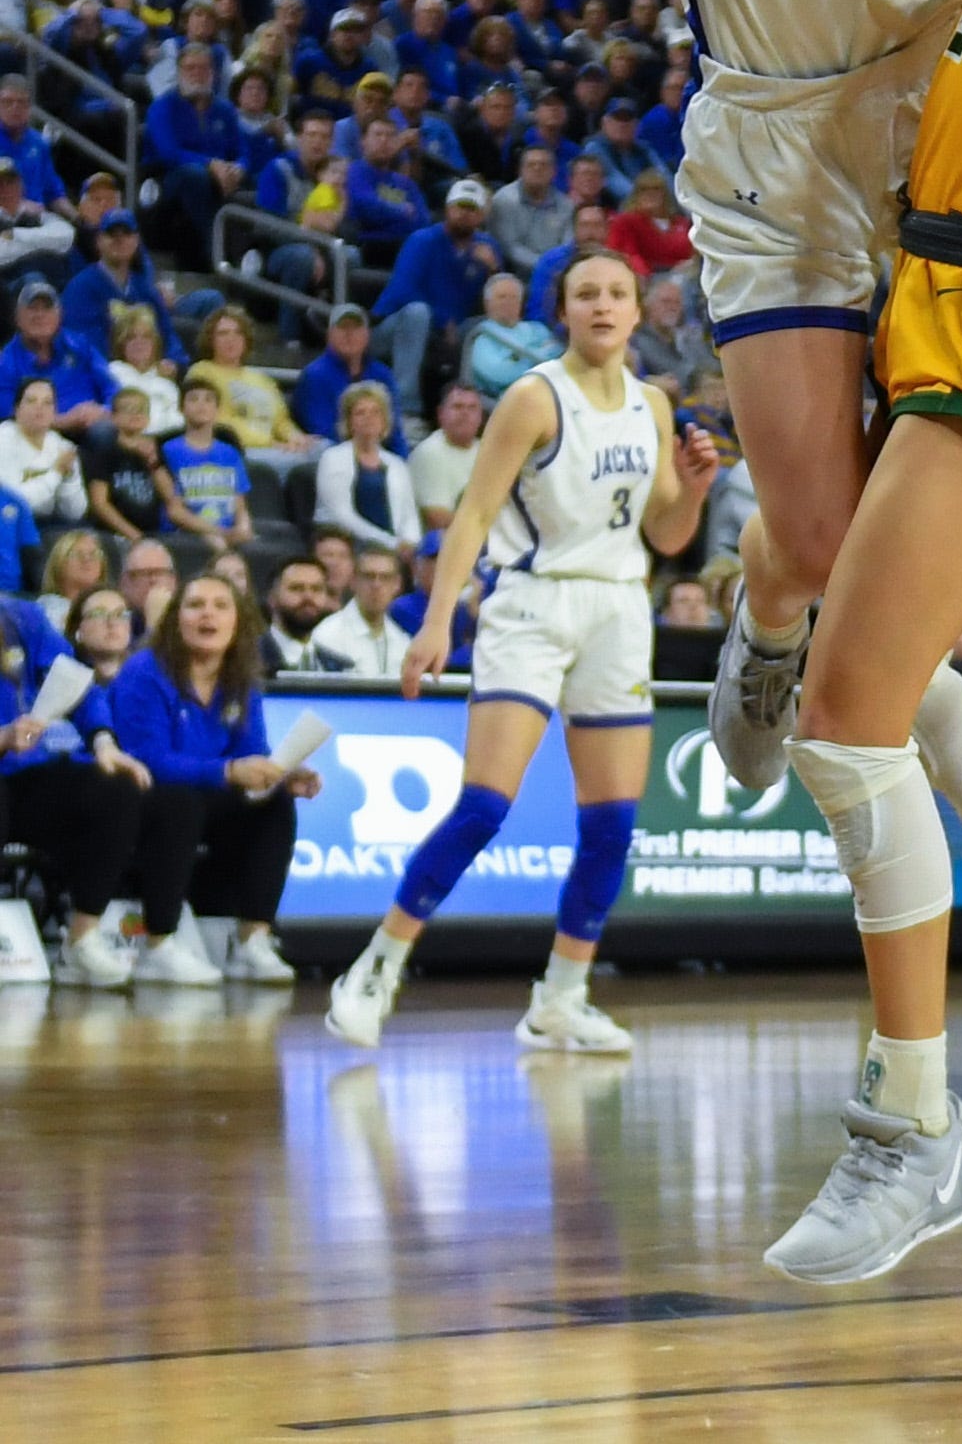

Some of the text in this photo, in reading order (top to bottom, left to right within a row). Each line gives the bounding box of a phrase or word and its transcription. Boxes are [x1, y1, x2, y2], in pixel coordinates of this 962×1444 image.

[591, 444, 649, 481] JACKS
[608, 487, 631, 530] 3
[290, 839, 576, 879] DAKTNICS
